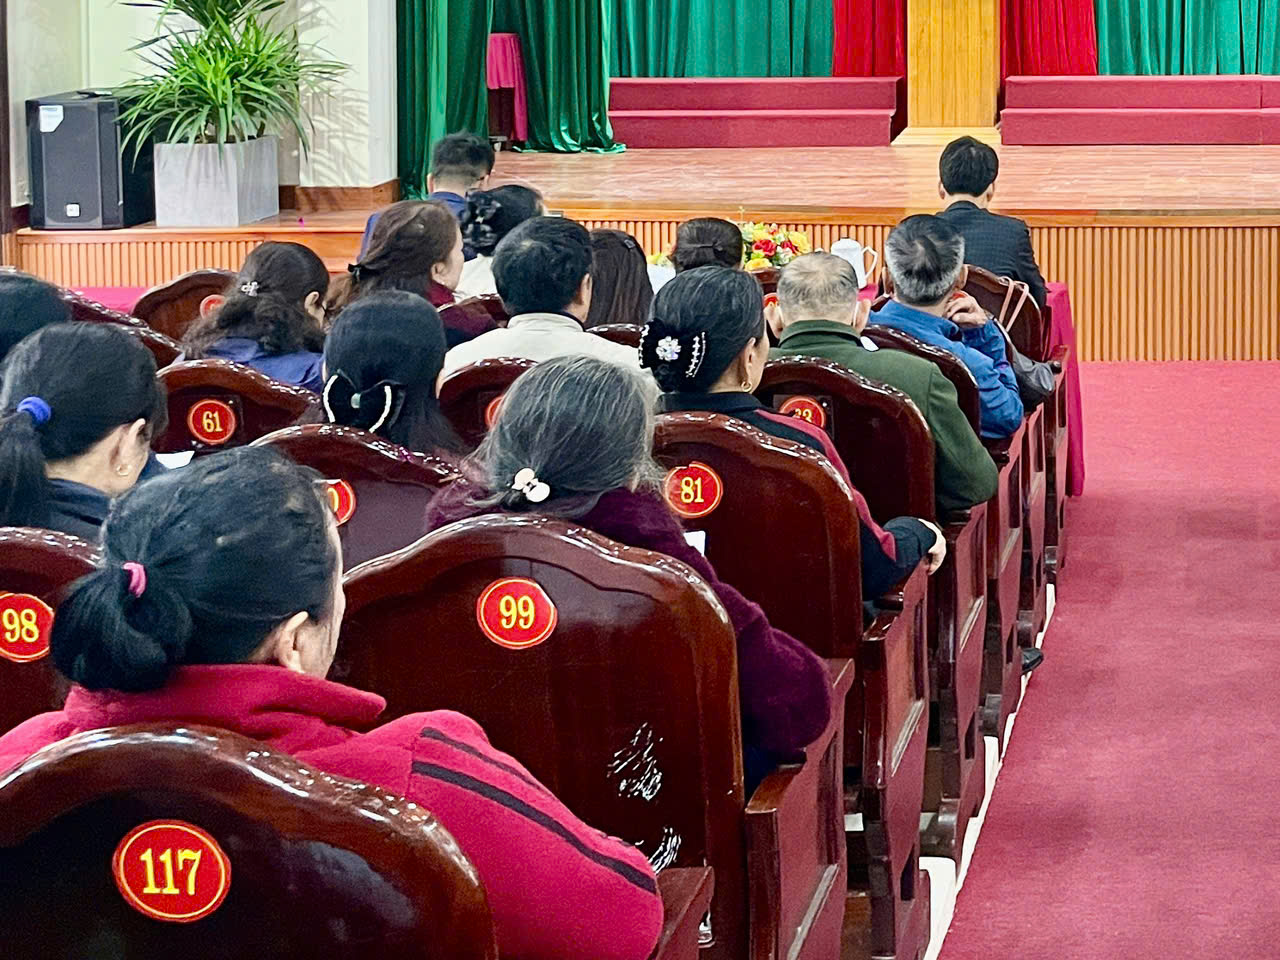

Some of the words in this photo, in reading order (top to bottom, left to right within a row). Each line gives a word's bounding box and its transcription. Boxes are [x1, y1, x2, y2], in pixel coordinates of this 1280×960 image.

[202, 411, 221, 434] 61
[681, 476, 704, 503] 81
[2, 608, 38, 644] 98
[498, 594, 535, 631] 99
[139, 848, 202, 897] 117
